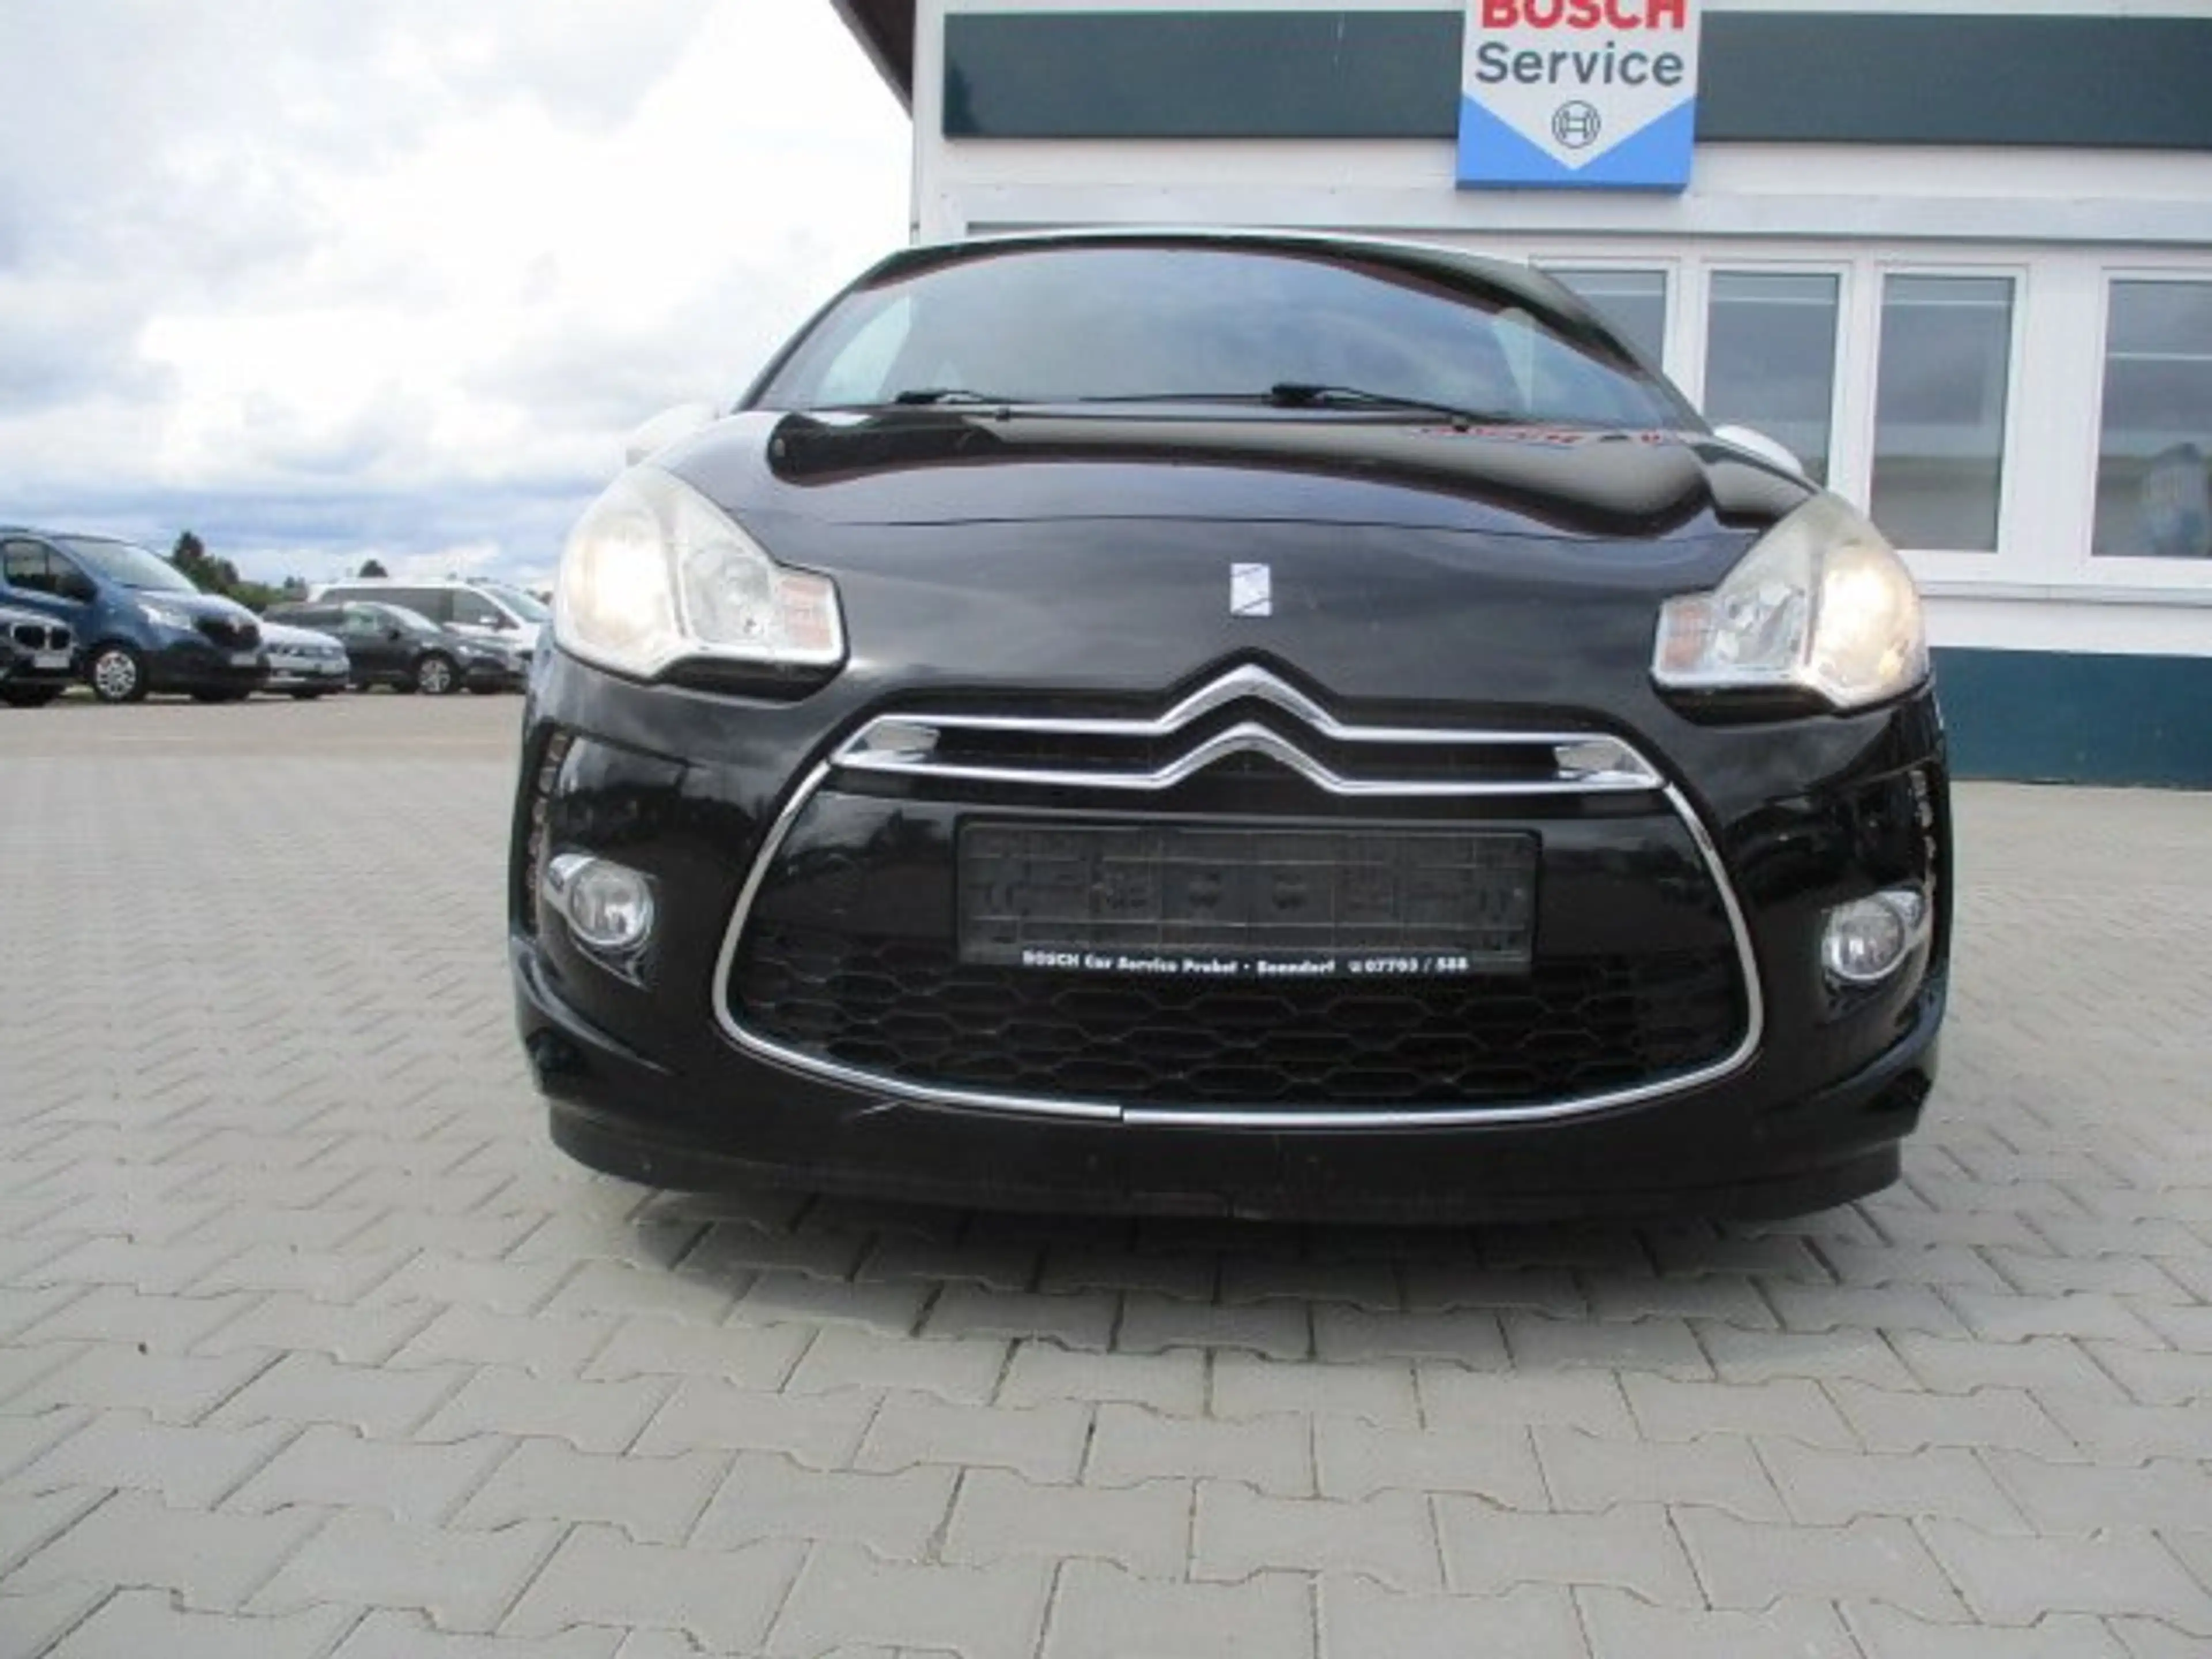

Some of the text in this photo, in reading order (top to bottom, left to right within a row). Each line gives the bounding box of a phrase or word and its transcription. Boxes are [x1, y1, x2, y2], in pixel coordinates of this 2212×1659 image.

[1476, 41, 1684, 86] Service
[1022, 950, 1080, 968] BOSCH
[1085, 953, 1113, 969] Car
[1116, 956, 1179, 972] Service
